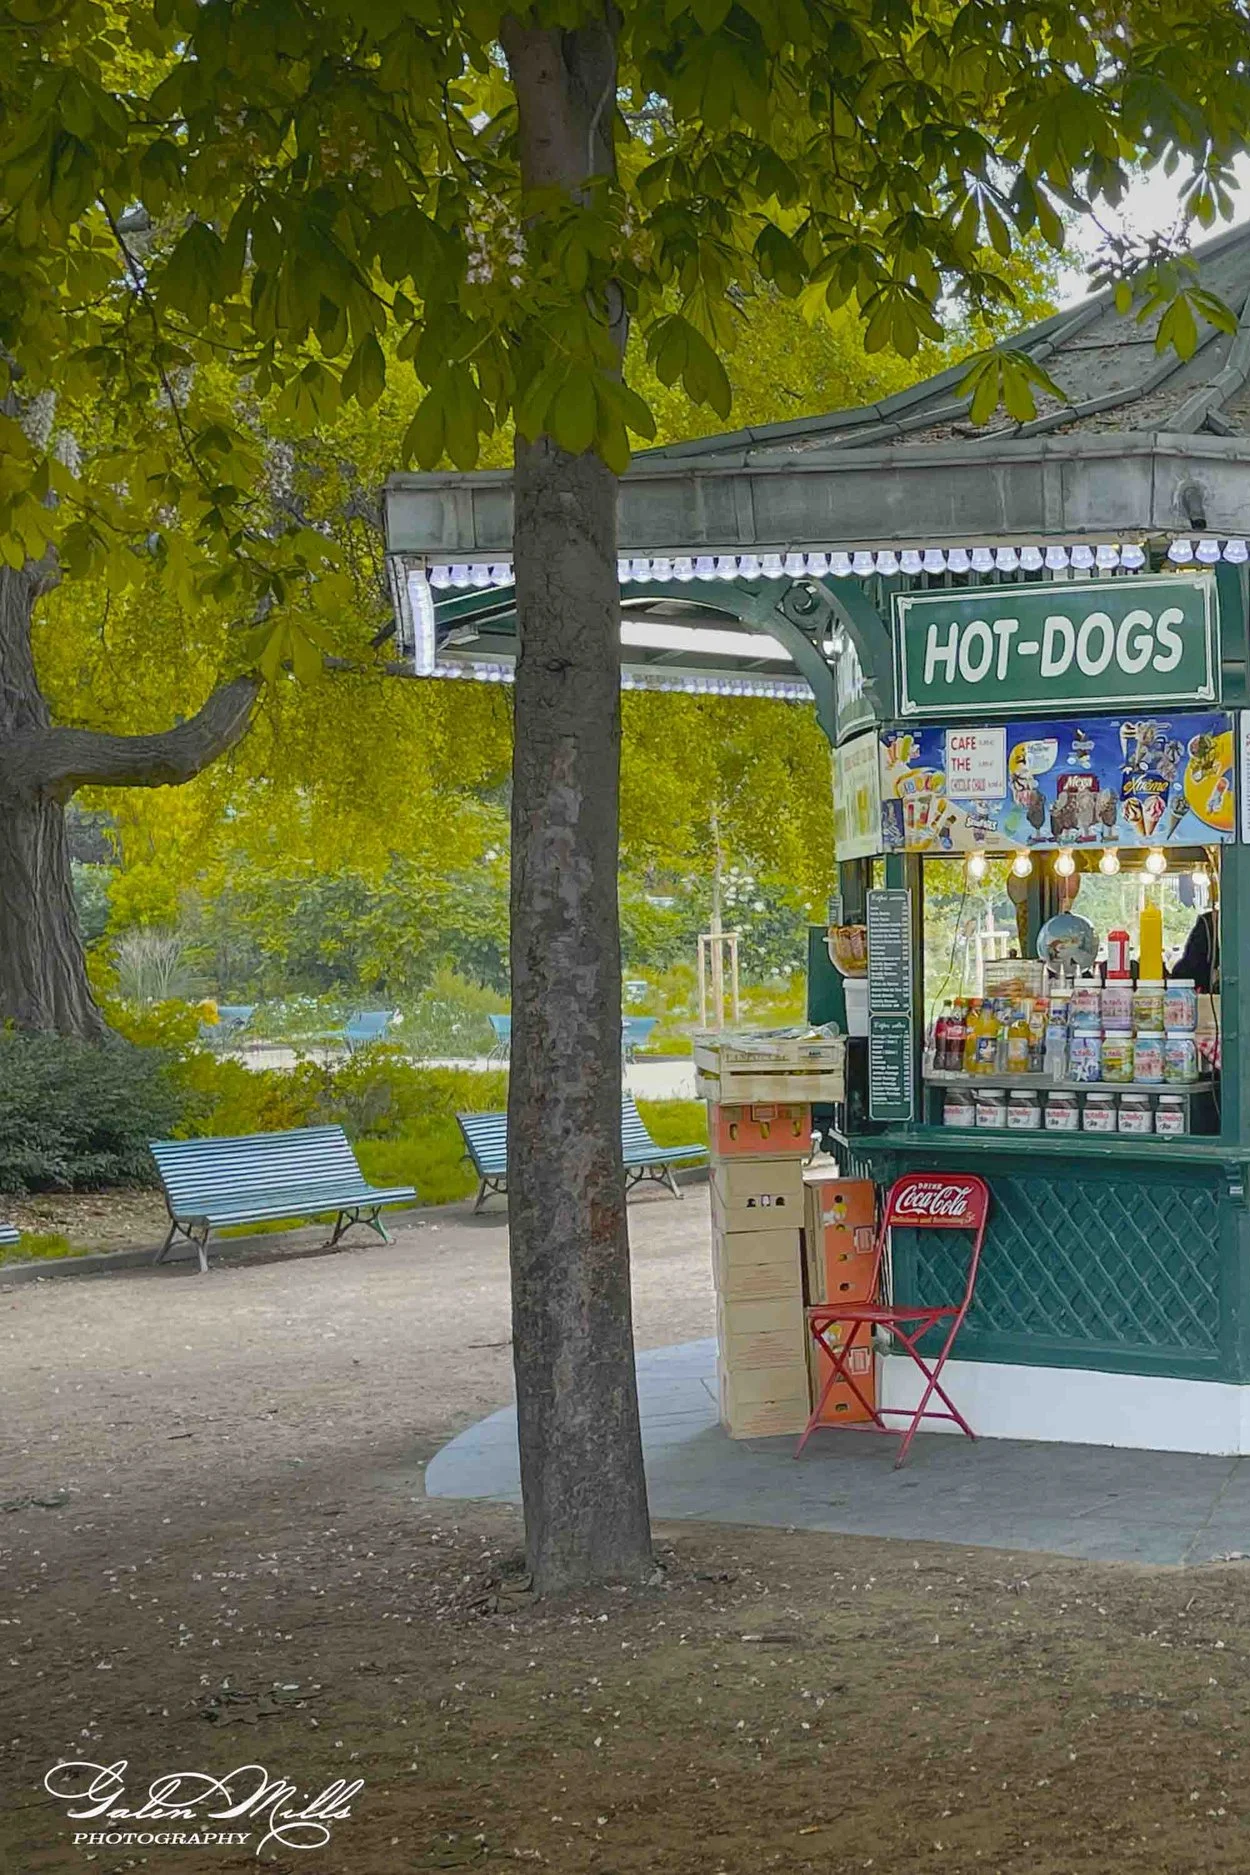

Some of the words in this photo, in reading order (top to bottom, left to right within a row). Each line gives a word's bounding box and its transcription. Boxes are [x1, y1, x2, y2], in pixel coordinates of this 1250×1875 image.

[924, 607, 1185, 685] HOT-DOGS
[950, 736, 977, 750] CAFE
[950, 757, 971, 771] THE
